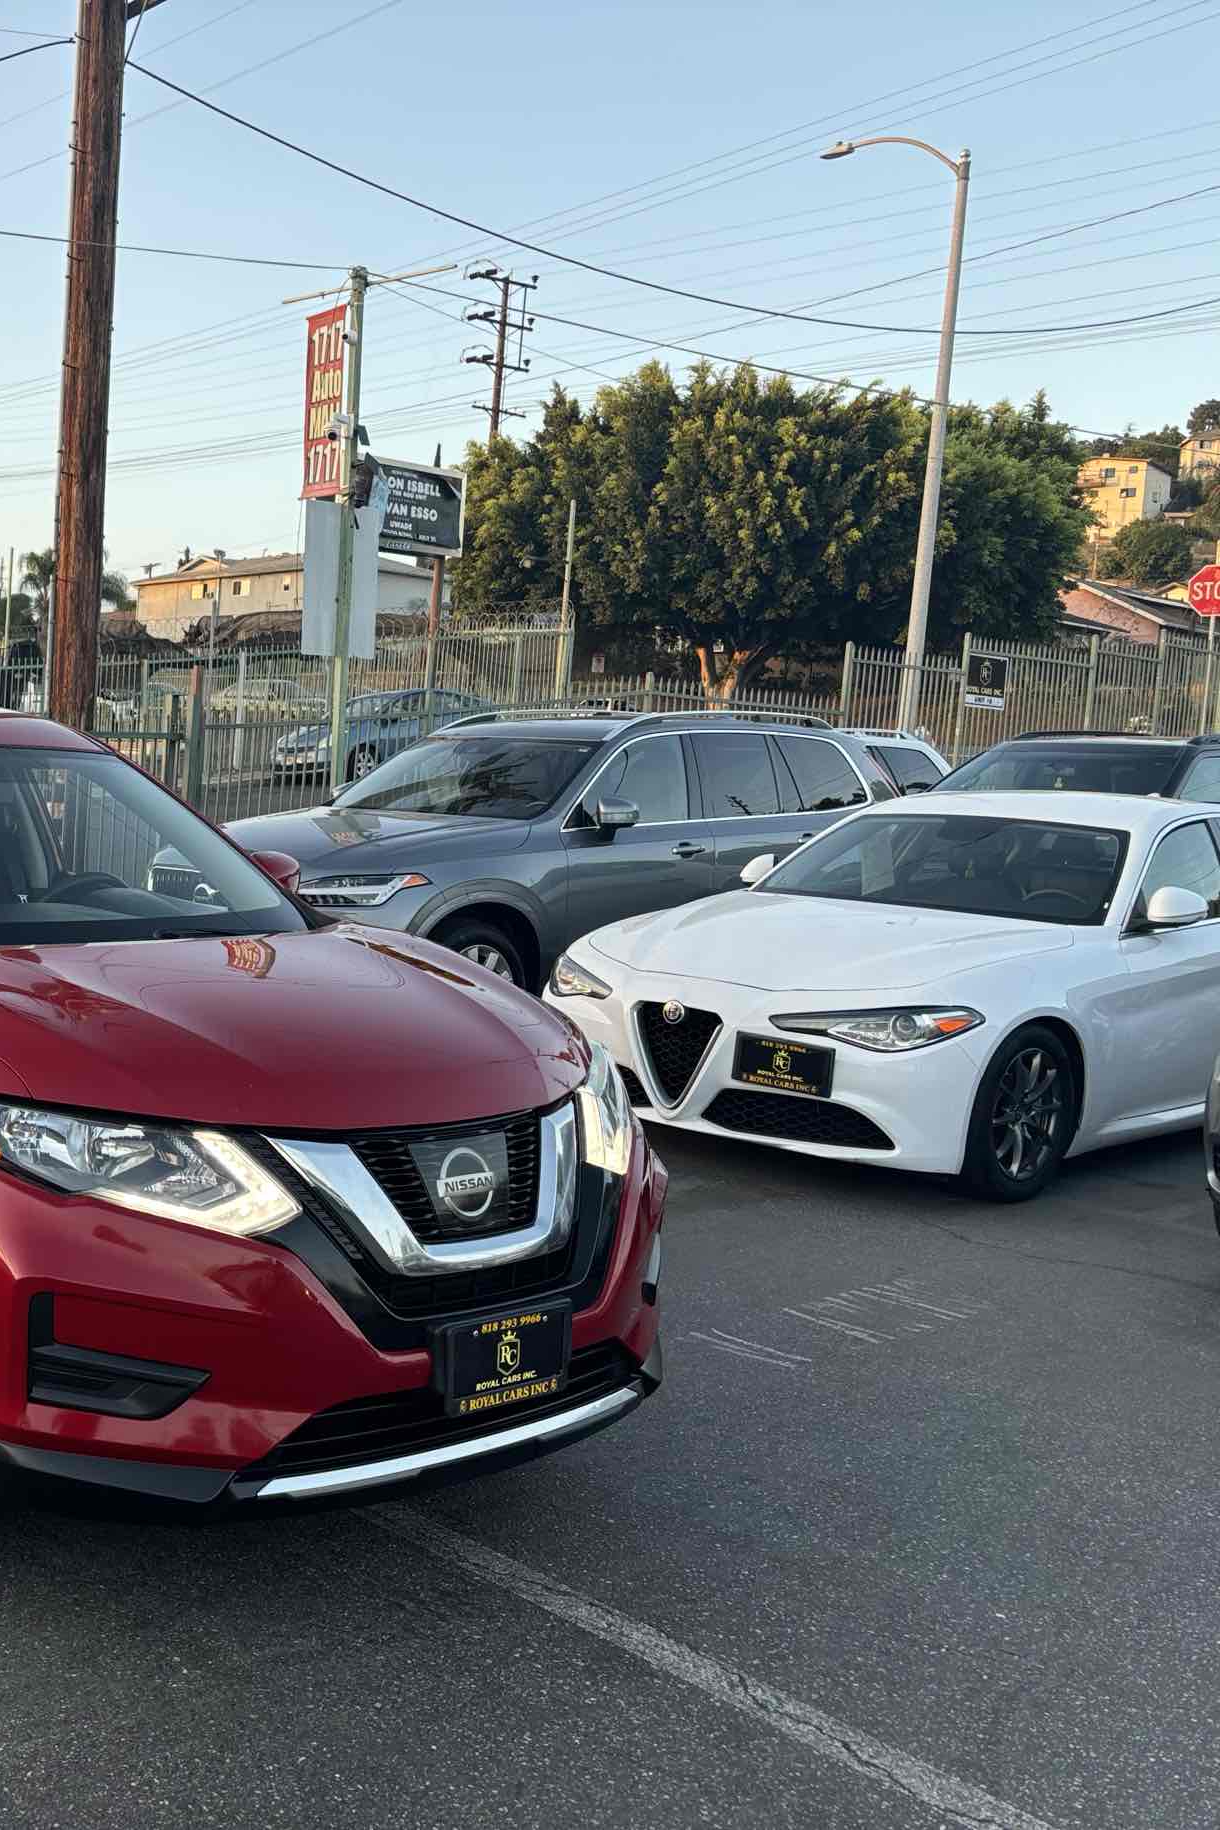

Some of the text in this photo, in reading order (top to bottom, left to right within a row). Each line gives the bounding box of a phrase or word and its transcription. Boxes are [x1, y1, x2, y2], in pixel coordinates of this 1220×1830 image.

[312, 319, 343, 366] 1717
[311, 370, 341, 403] Auto
[308, 441, 339, 484] 1717
[407, 480, 441, 497] ISBELL
[411, 506, 438, 522] ESSO
[444, 1176, 493, 1193] NISSAN
[481, 1313, 542, 1334] 818 293 9966
[501, 1345, 517, 1366] RC
[475, 1378, 500, 1391] ROYAL
[501, 1374, 522, 1385] CARS
[469, 1382, 549, 1411] ROYAL CARS INC
